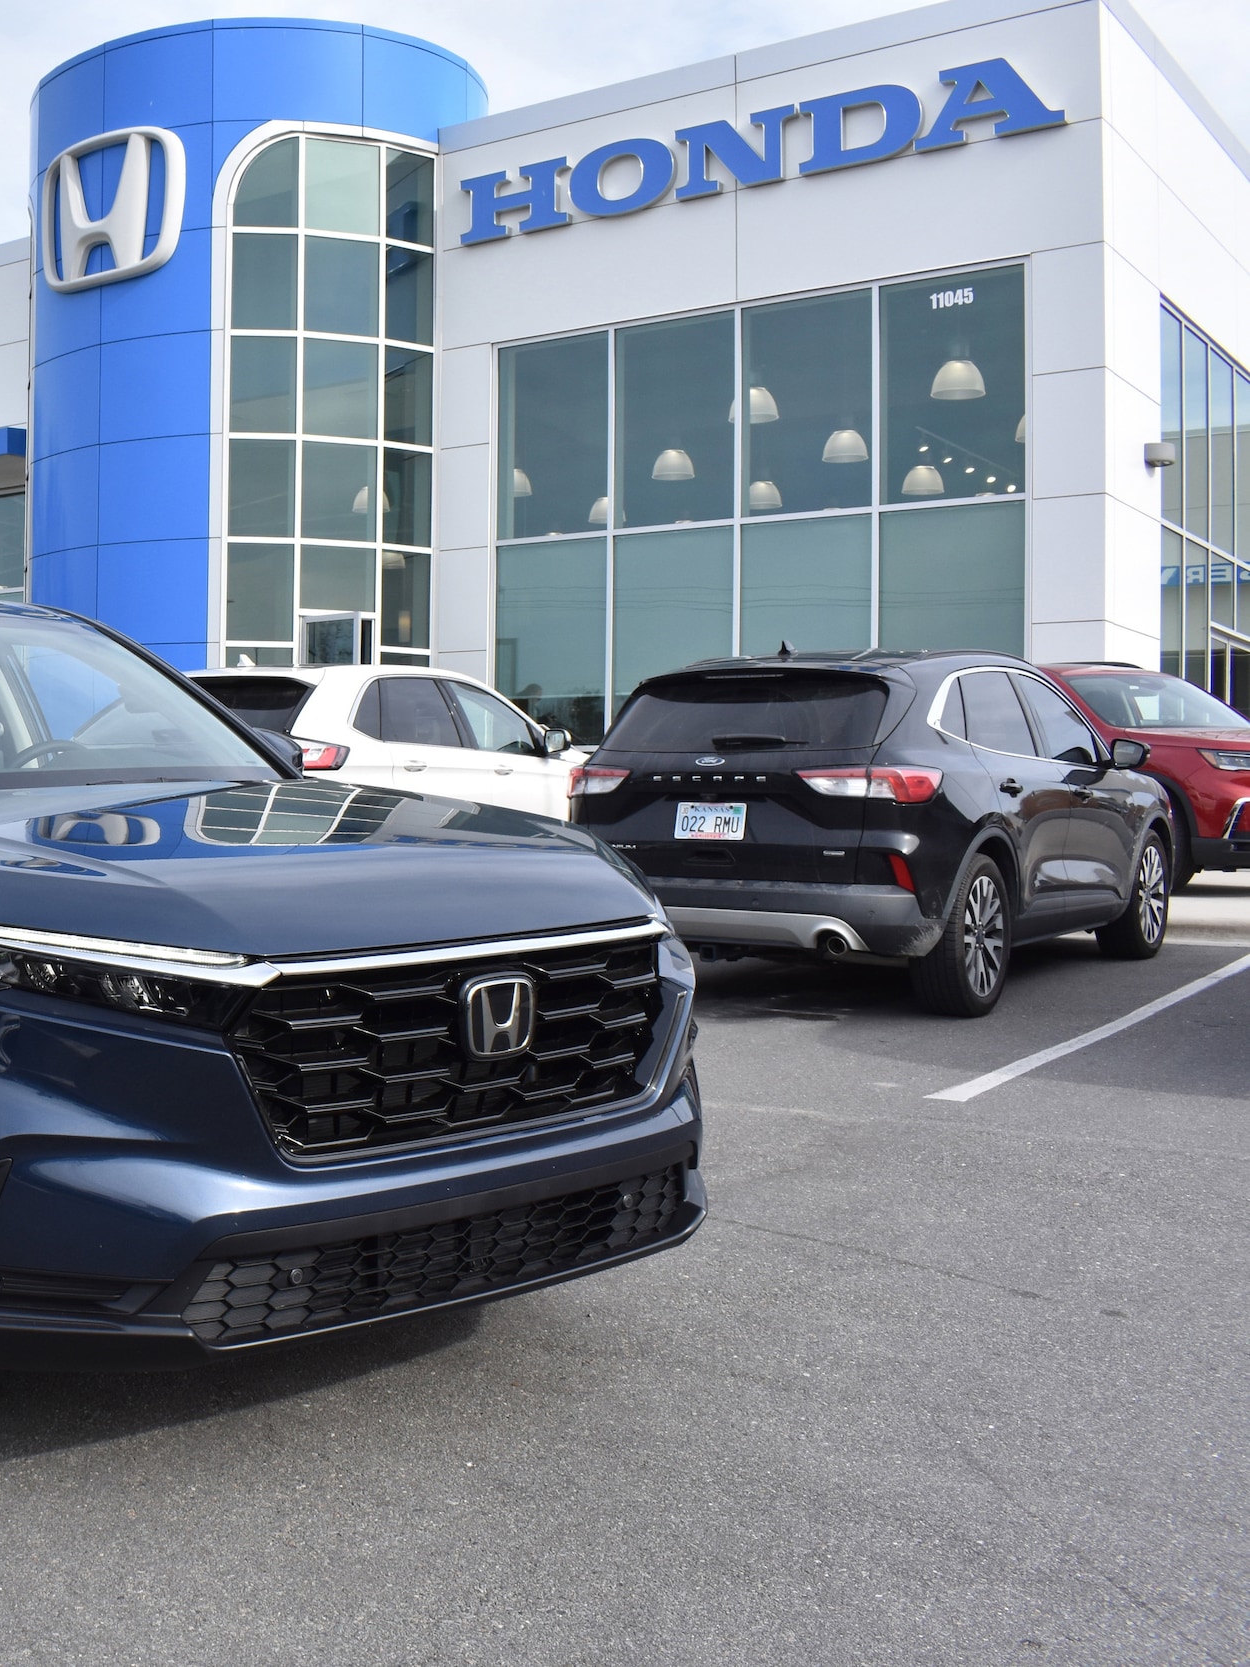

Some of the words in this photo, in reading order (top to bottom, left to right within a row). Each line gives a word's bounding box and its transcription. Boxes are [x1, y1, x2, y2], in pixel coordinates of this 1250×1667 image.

[460, 57, 1067, 246] HONDA
[930, 287, 974, 309] 11045
[681, 815, 706, 831] 022
[714, 816, 740, 833] RMU
